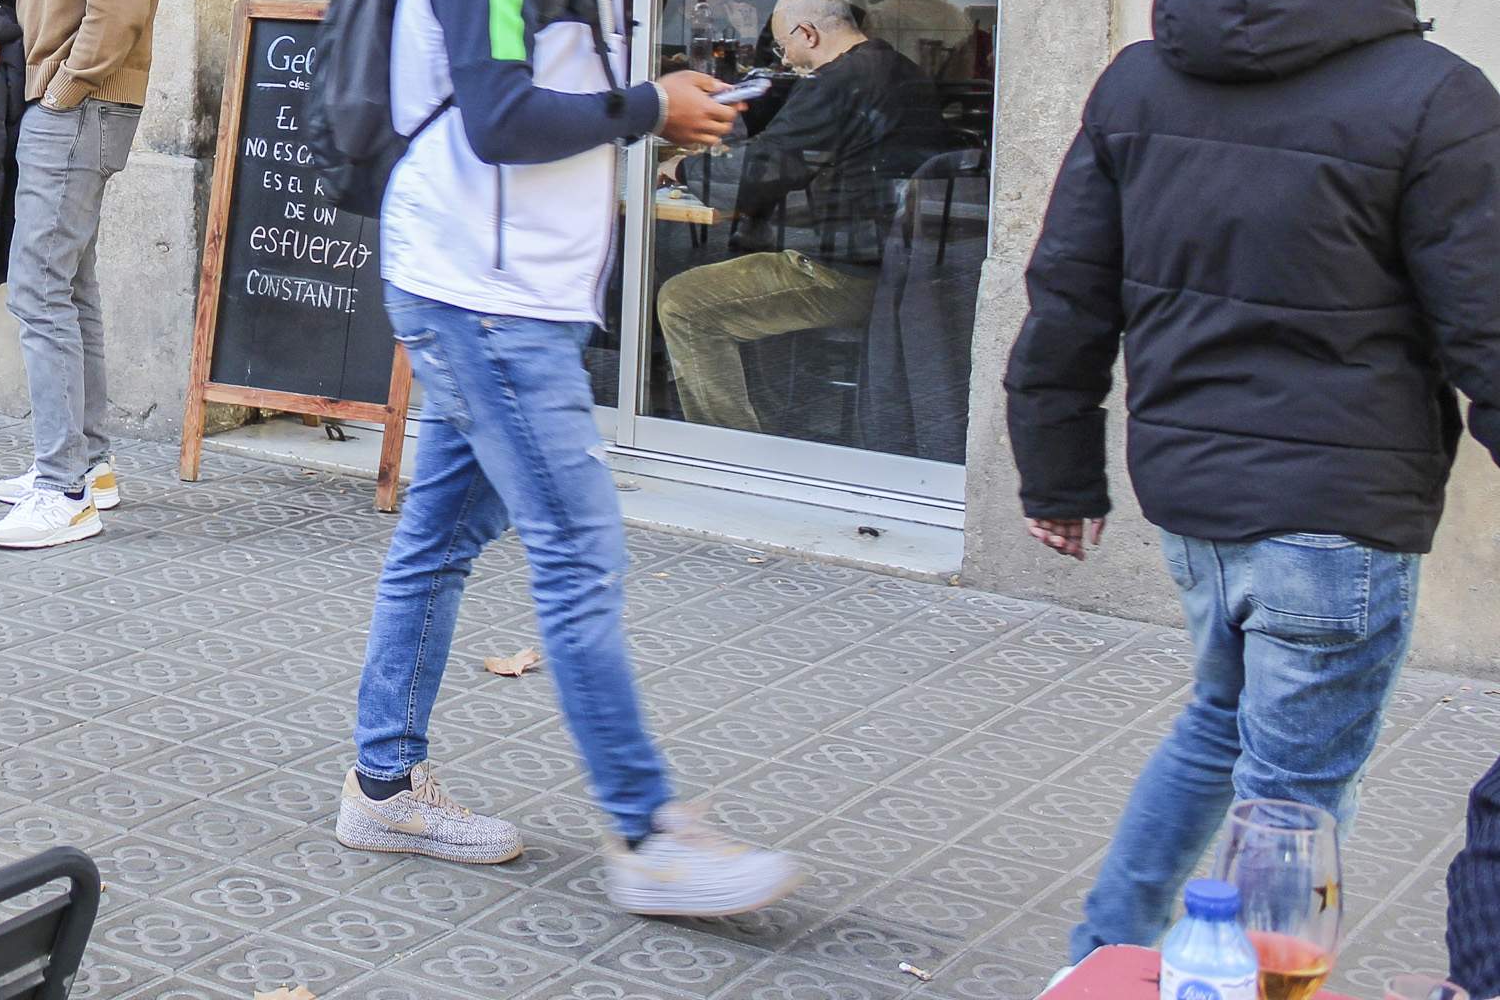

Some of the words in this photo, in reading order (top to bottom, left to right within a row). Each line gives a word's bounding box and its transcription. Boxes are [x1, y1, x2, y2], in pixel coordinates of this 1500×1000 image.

[267, 35, 316, 75] Gel
[288, 76, 310, 91] des
[276, 105, 299, 131] EL
[245, 137, 268, 158] NO
[273, 142, 293, 161] ES
[263, 171, 282, 191] ES
[288, 176, 303, 193] EL
[284, 202, 306, 220] DE
[313, 207, 337, 226] UN
[250, 225, 372, 269] esfuerzo
[247, 269, 358, 313] CONSTANTE
